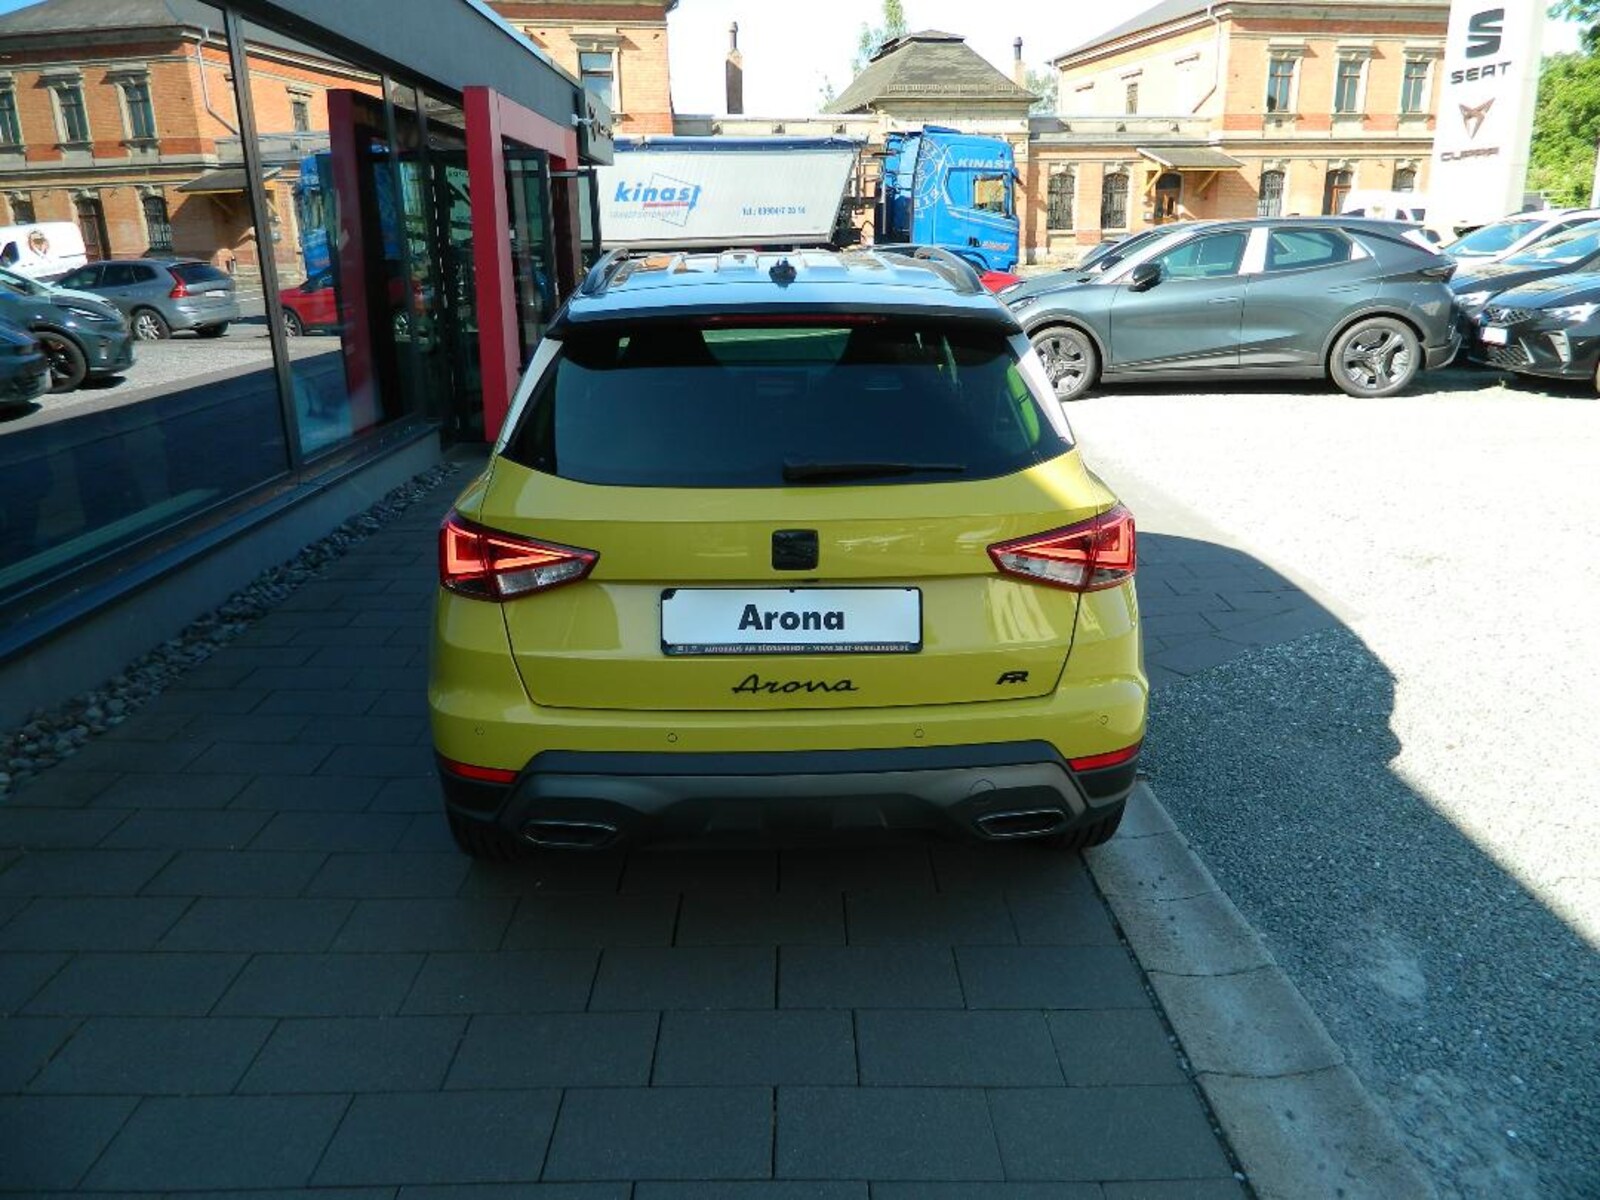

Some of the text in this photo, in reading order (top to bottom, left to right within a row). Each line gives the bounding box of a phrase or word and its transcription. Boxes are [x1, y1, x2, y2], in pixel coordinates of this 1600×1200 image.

[1450, 61, 1512, 85] SEAT
[957, 158, 1012, 170] KINAST
[738, 604, 845, 631] Arona
[731, 673, 860, 694] Arona
